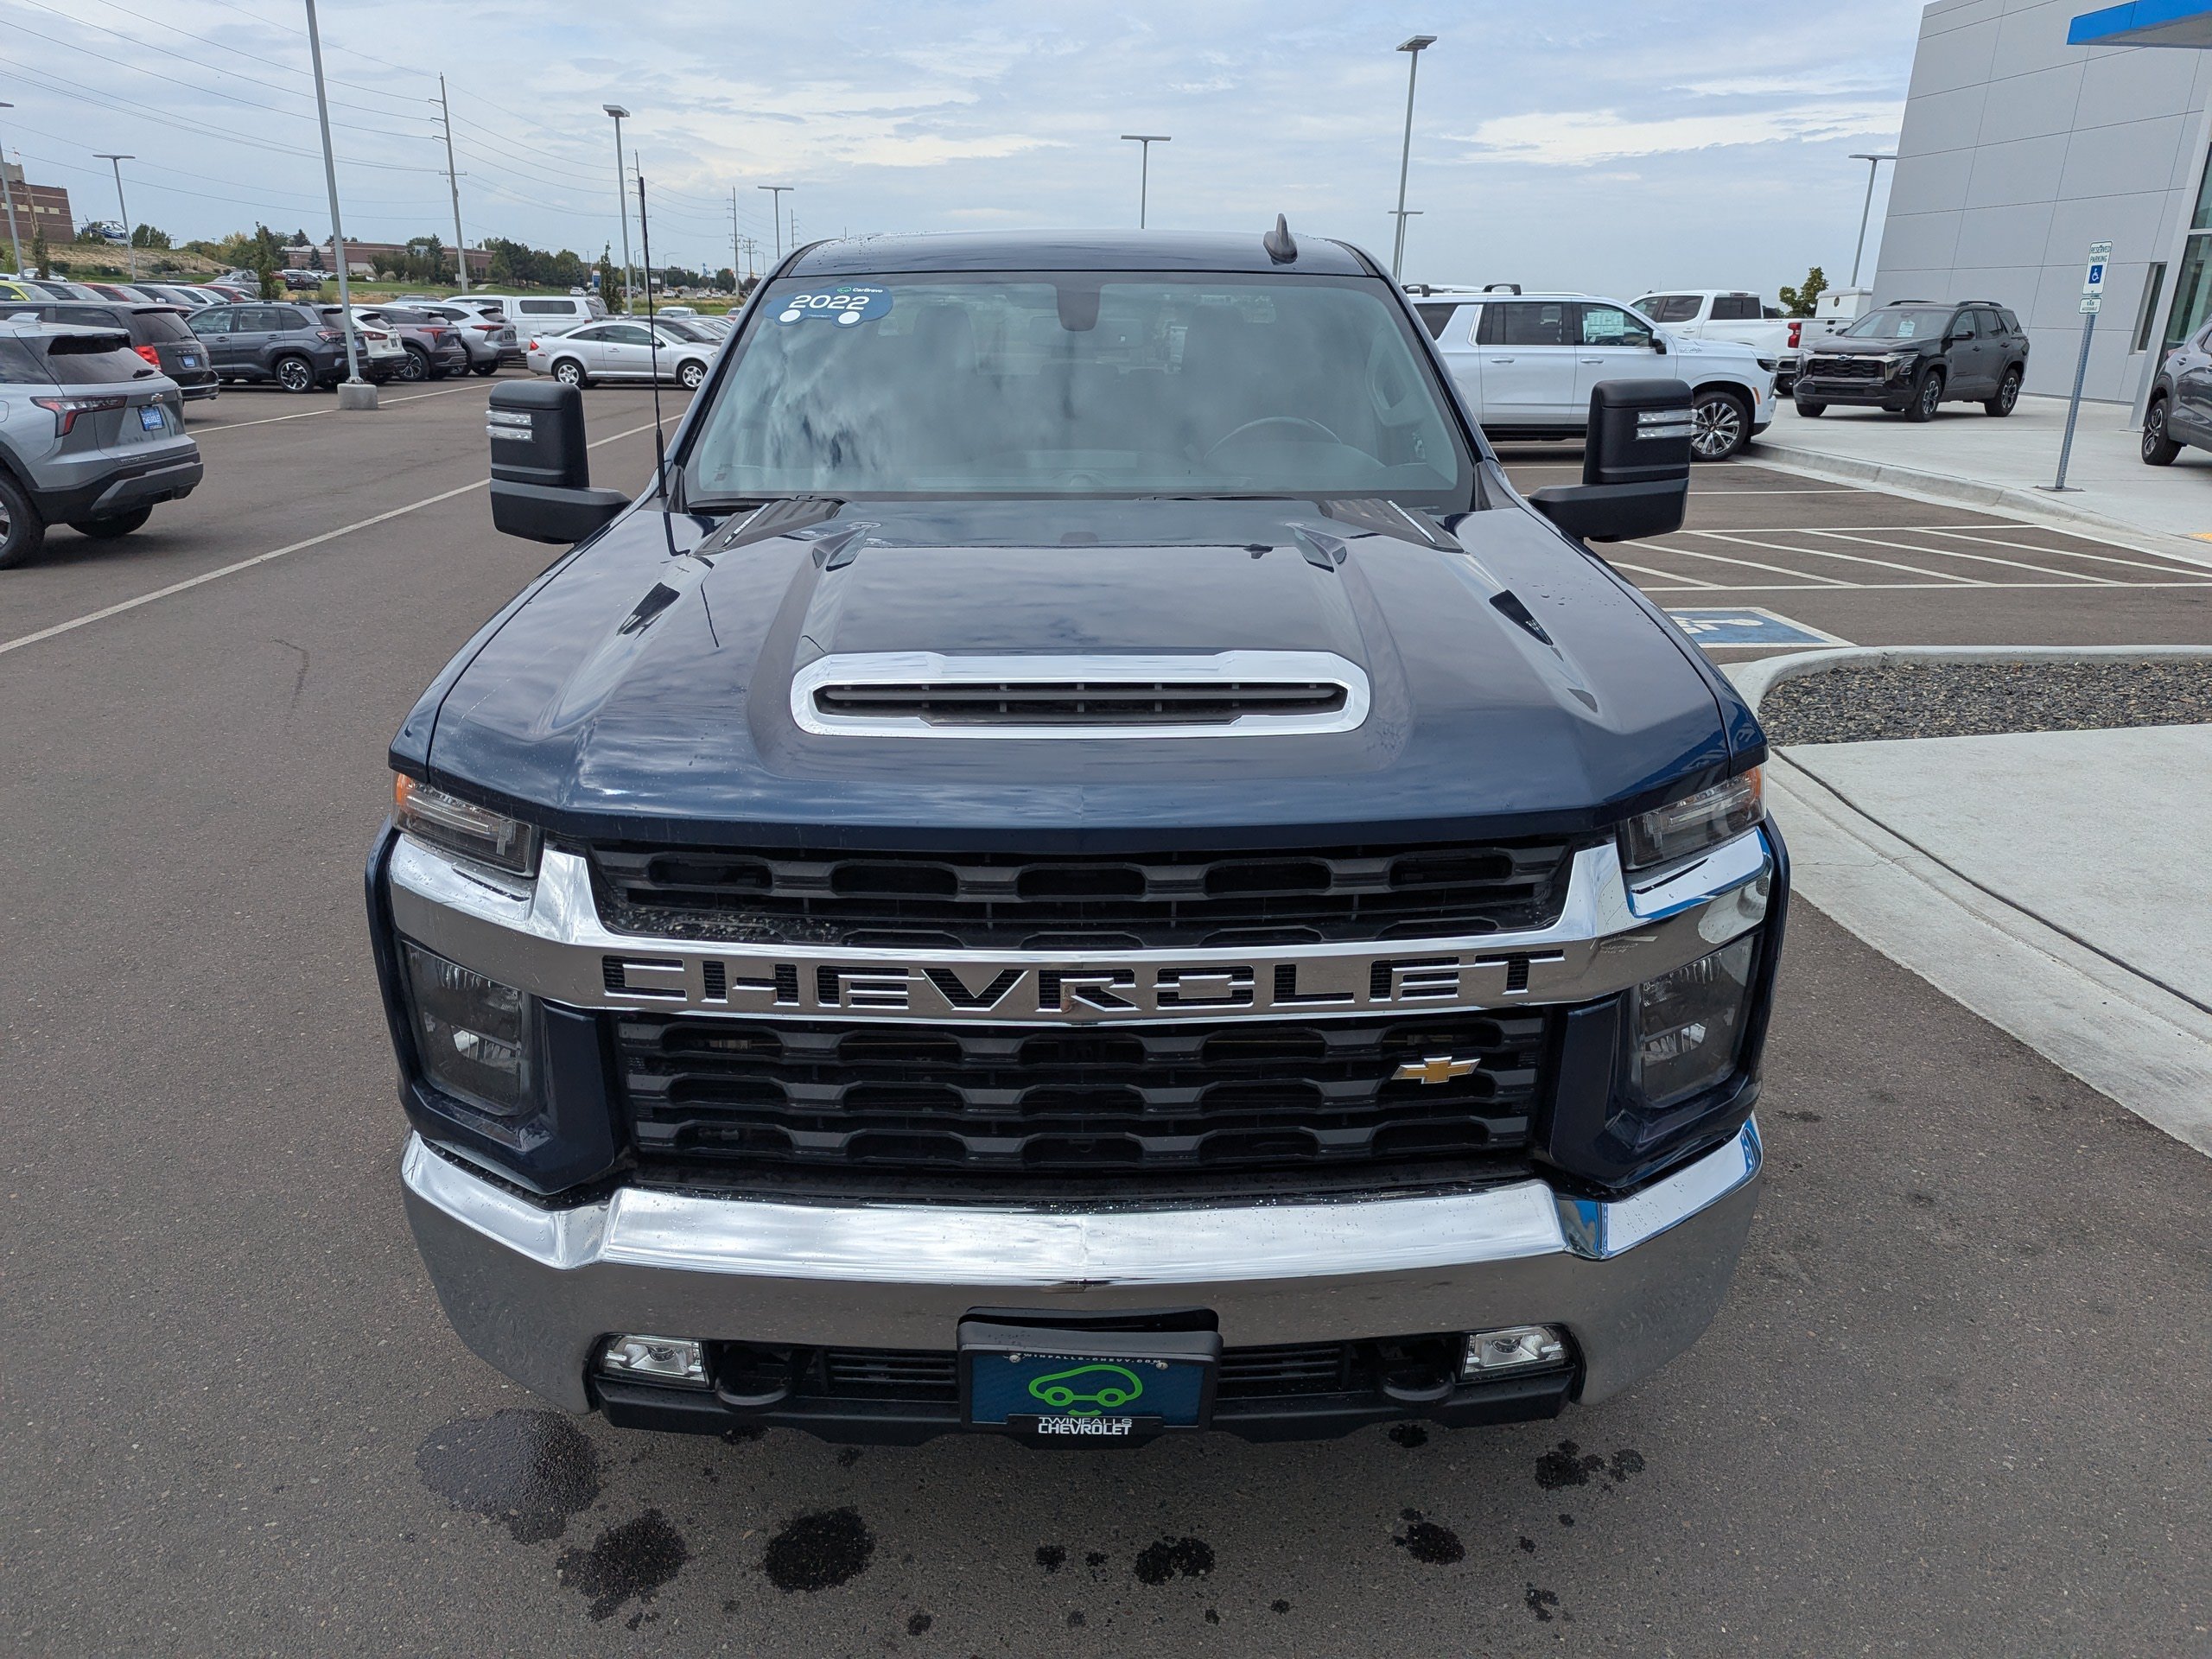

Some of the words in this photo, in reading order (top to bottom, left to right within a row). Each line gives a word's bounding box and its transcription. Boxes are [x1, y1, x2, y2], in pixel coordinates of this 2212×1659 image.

[788, 295, 870, 310] 2022
[602, 949, 1566, 1013] CHEVROLET
[1038, 1423, 1132, 1435] CHEVROLET
